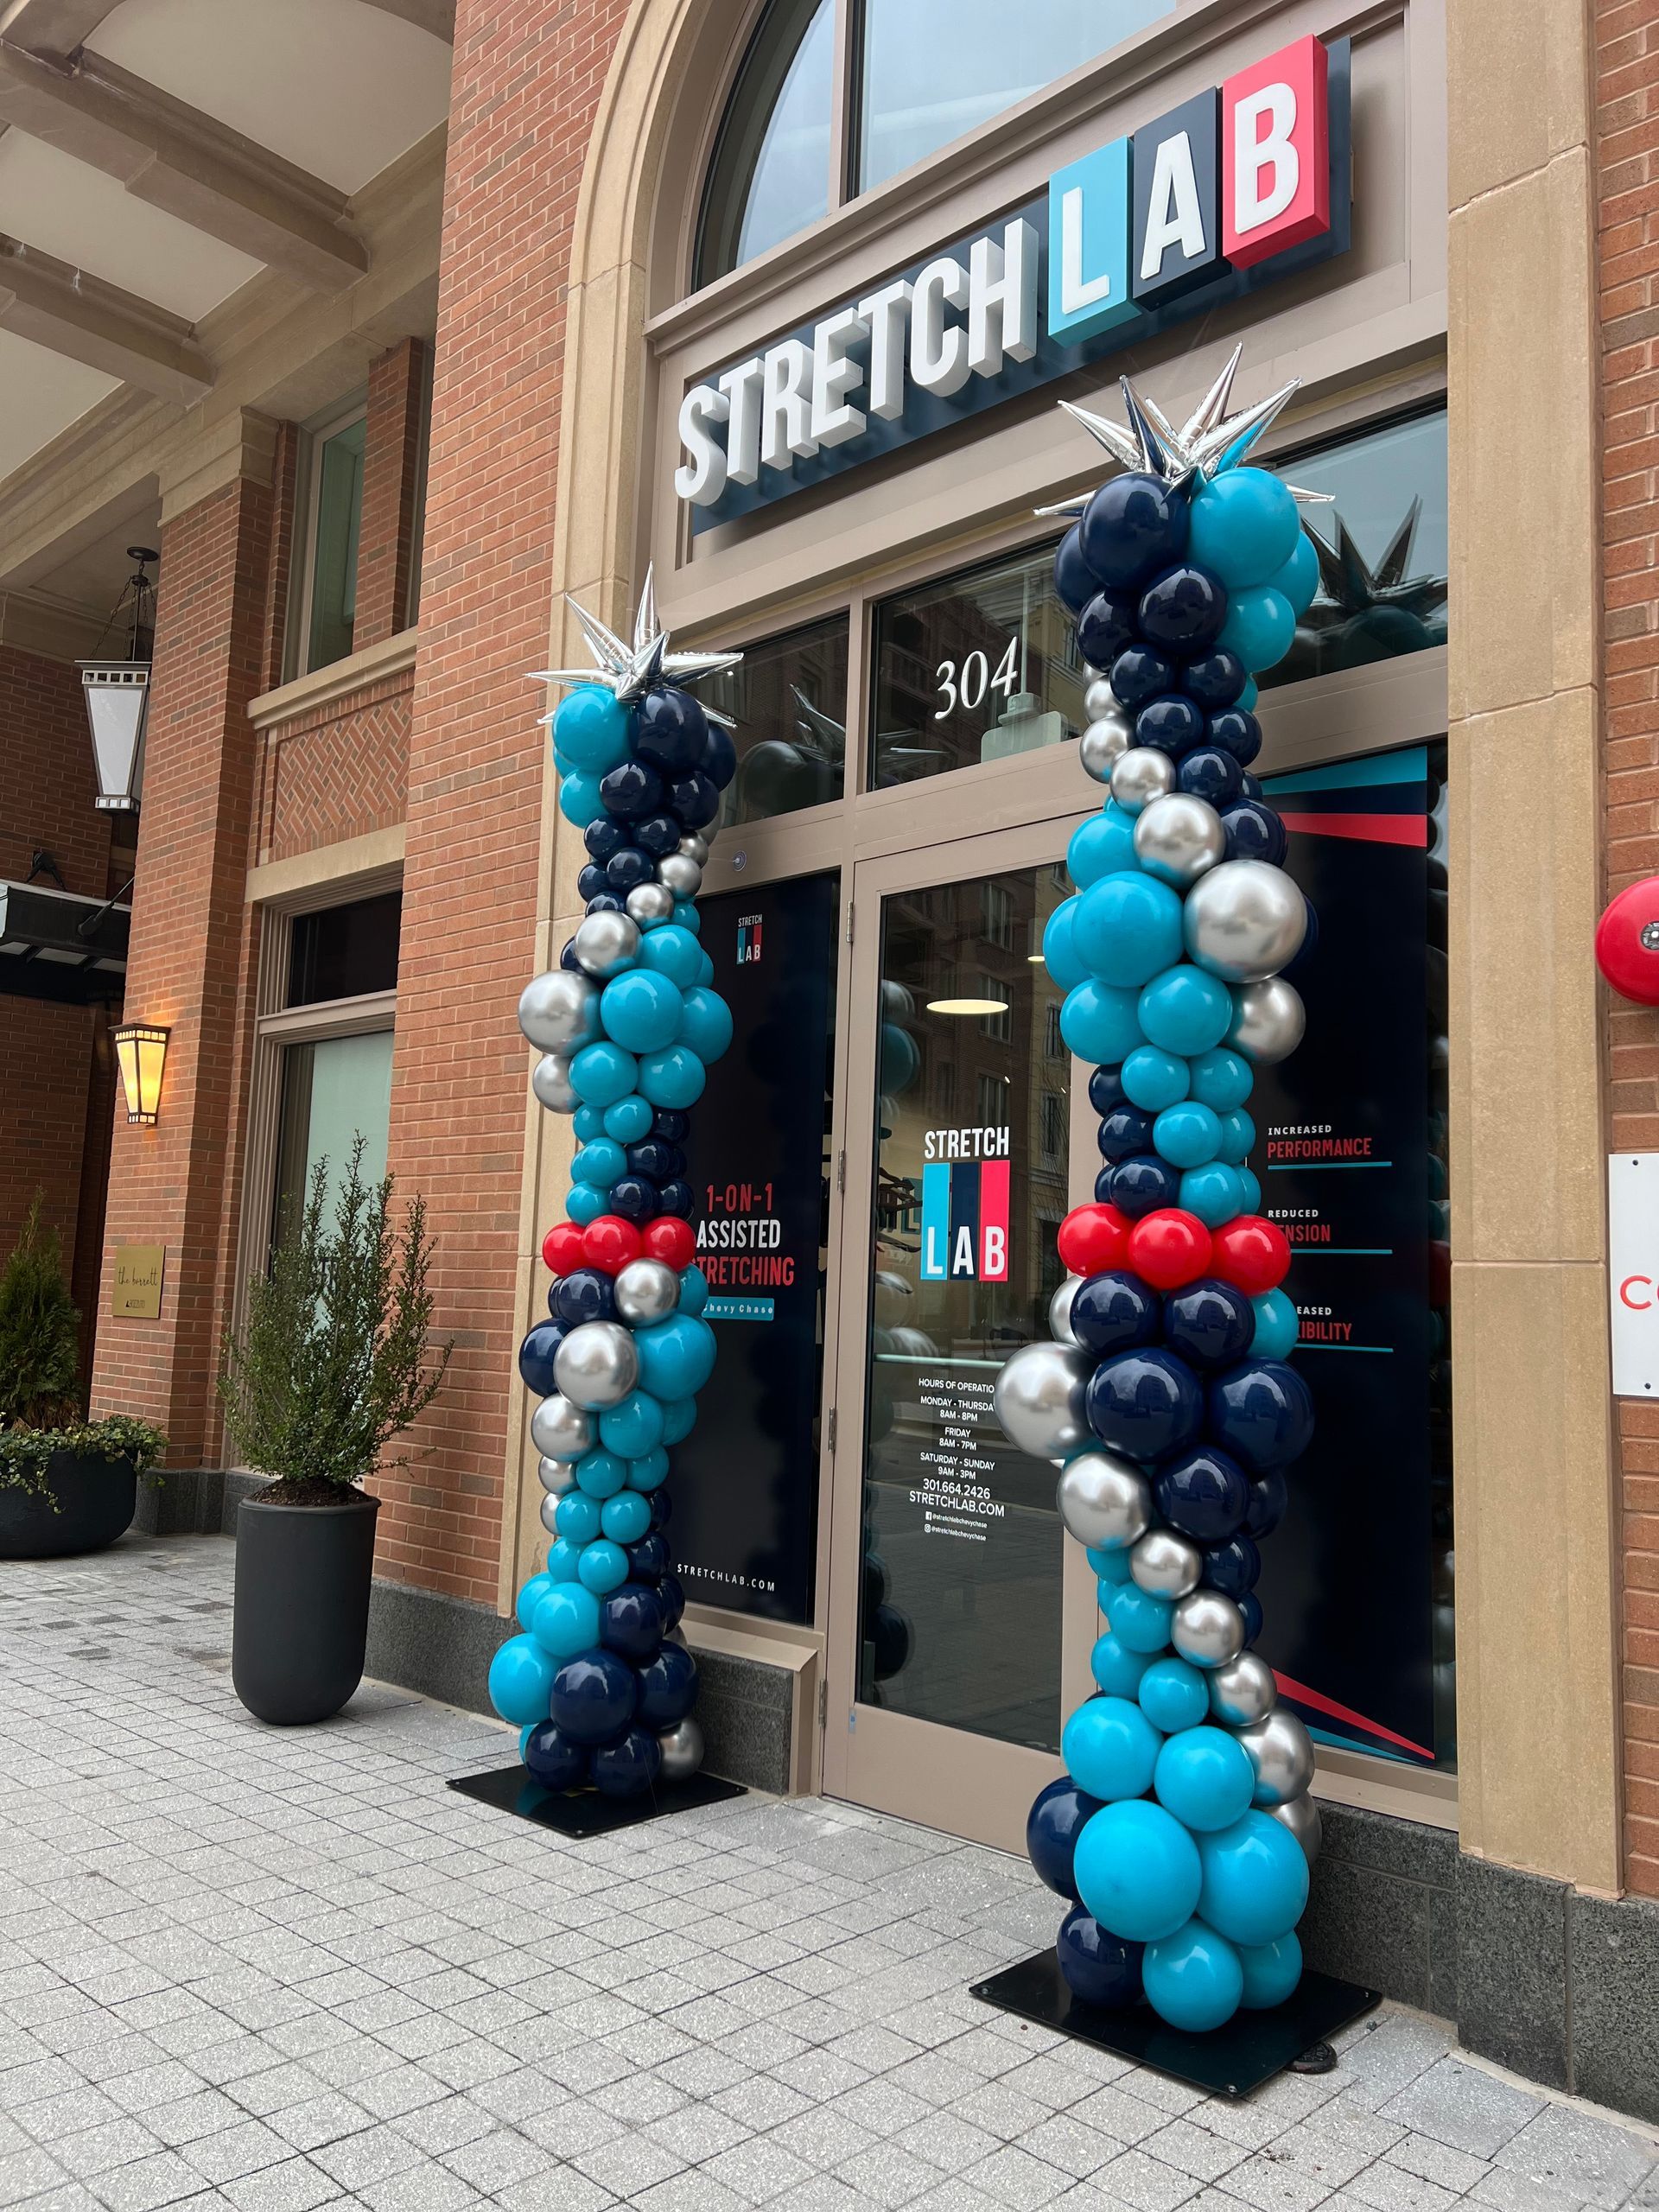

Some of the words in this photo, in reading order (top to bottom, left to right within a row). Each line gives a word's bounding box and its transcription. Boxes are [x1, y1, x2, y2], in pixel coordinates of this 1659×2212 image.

[675, 217, 1039, 507] STRETCH
[1061, 81, 1300, 315] LAB
[934, 636, 1019, 720] 304
[738, 913, 763, 927] STRETCH
[737, 944, 761, 963] LAB
[1268, 1124, 1332, 1135] INCREASED
[924, 1126, 1010, 1160] STRETCH
[1267, 1137, 1372, 1159] PERFORMANCE
[706, 1183, 773, 1212] 1-ON-1
[1268, 1209, 1319, 1217] REDUCED
[696, 1218, 781, 1249] ASSISTED
[1278, 1224, 1331, 1242] NSION
[926, 1225, 1006, 1276] LAB
[692, 1255, 795, 1286] TRETCHING
[1619, 1274, 1659, 1310] C
[739, 1304, 773, 1314] Chase
[1297, 1306, 1332, 1315] EASED
[1298, 1321, 1352, 1341] IBILITY
[918, 1377, 944, 1389] HOURS
[945, 1381, 957, 1389] OF
[957, 1382, 995, 1394] OPERATIO
[920, 1395, 952, 1407] MONDAY
[958, 1400, 995, 1412] THURSDA
[939, 1409, 957, 1419] 8AM
[962, 1412, 978, 1421] 8PM
[944, 1427, 971, 1438] FRIDAY
[939, 1438, 956, 1448] 8AM
[962, 1441, 977, 1451] 7PM
[920, 1452, 958, 1465] SATURDAY
[963, 1459, 995, 1471] SUNDAY
[938, 1466, 955, 1477] 9AM
[960, 1470, 976, 1480] 3PM
[923, 1478, 991, 1500] 301.664.2426
[909, 1491, 1005, 1517] STRETCHLAB.COM
[677, 1563, 775, 1592] STRETCHLAB.COM
